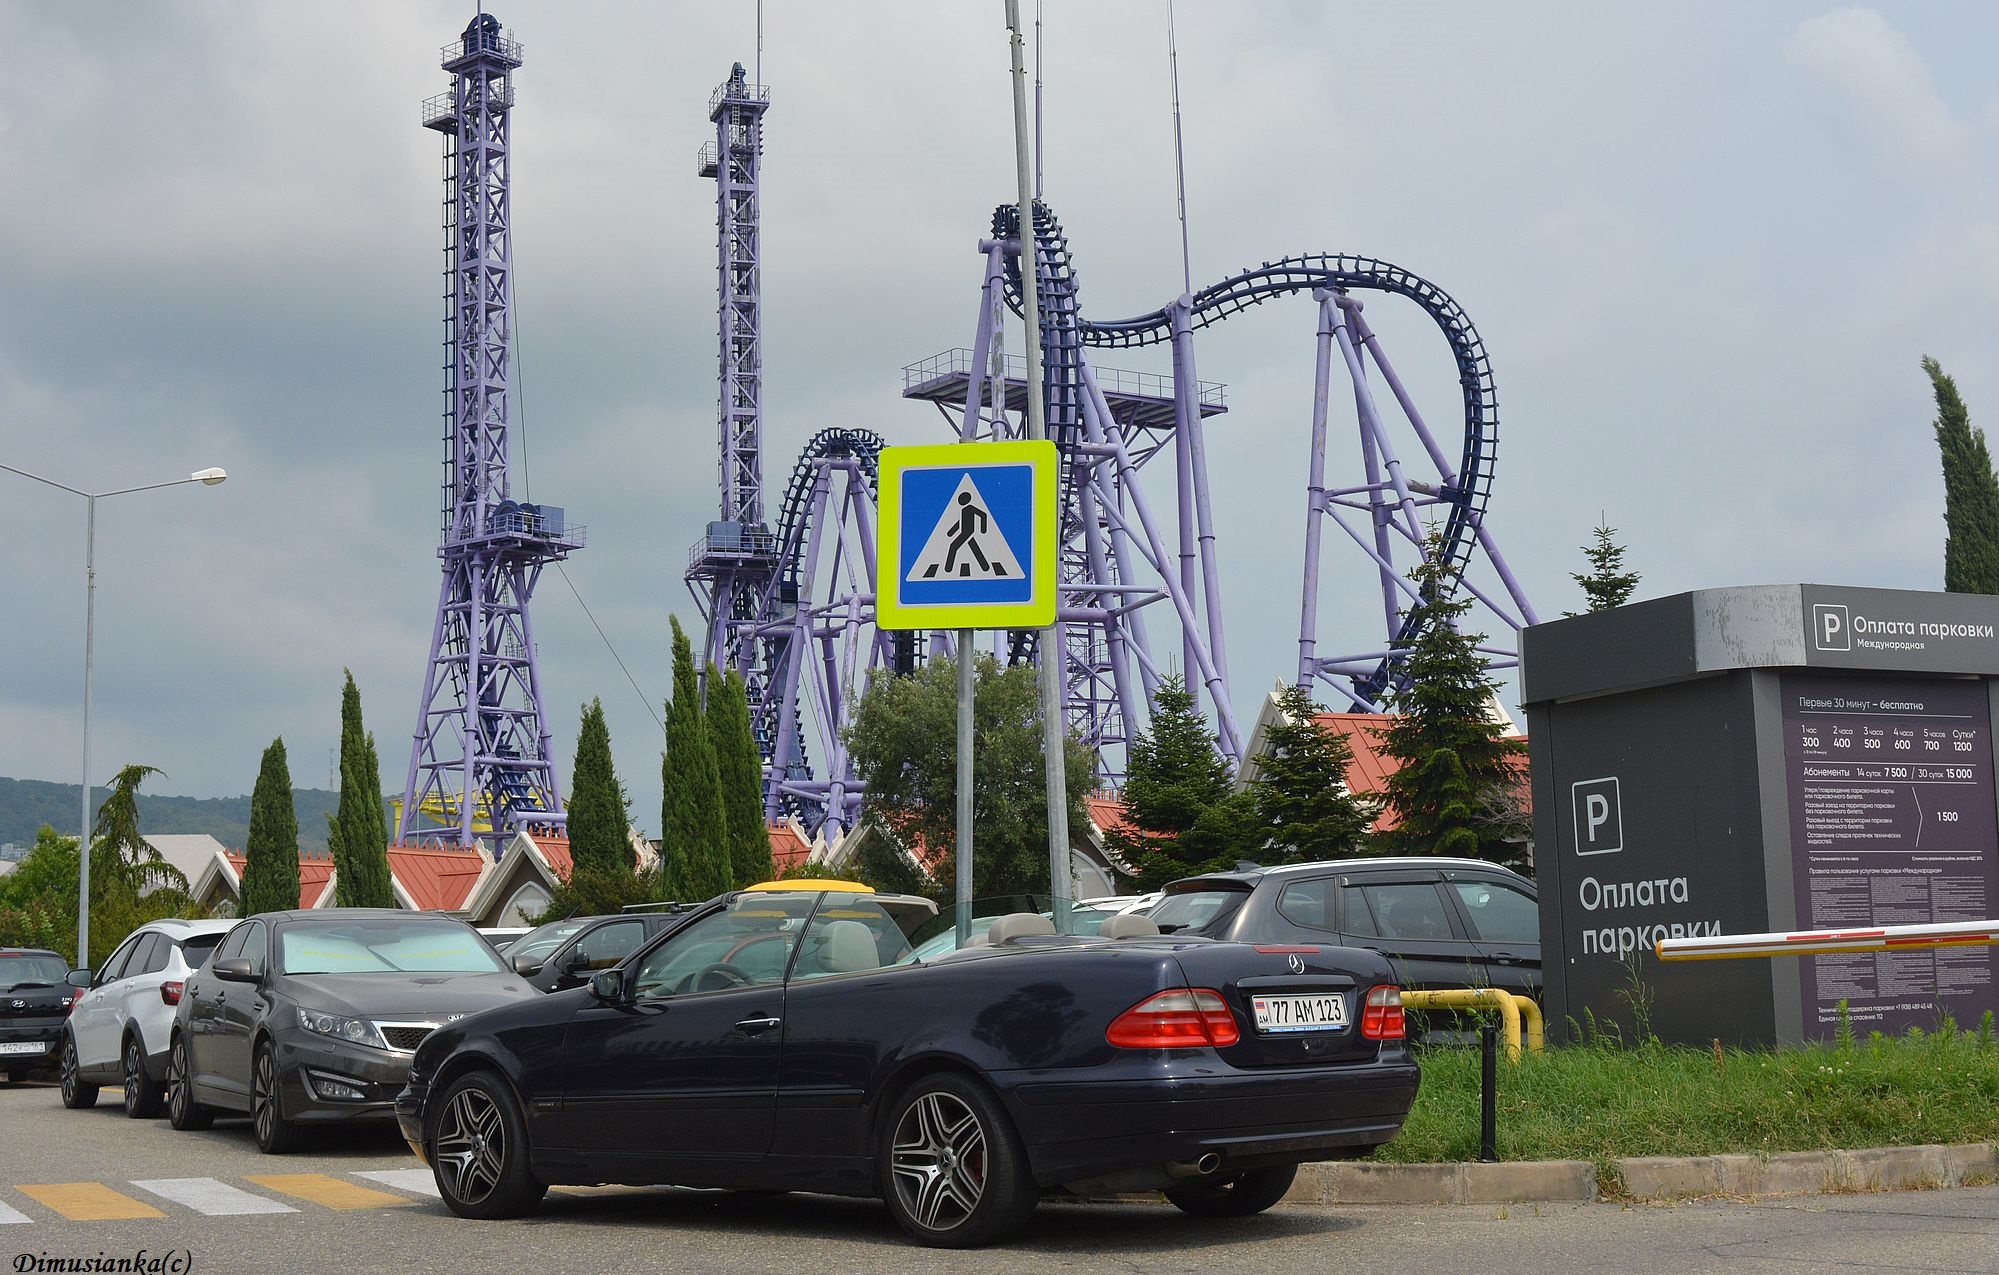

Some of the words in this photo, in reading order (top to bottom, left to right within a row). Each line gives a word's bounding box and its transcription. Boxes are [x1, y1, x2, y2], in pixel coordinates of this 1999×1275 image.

[1824, 613, 1840, 642] P
[1853, 615, 1915, 635] Оплата
[1920, 621, 1994, 640] парковки
[1857, 638, 1925, 650] Международная
[1800, 697, 1832, 709] Первые
[1834, 698, 1845, 708] 30
[1846, 700, 1870, 710] минут
[1880, 700, 1923, 710] бесплатно
[1801, 725, 1806, 733] 1
[1833, 726, 1838, 734] 2
[1863, 727, 1868, 735] 3
[1893, 727, 1899, 736] 4
[1923, 728, 1928, 737] 5
[1802, 737, 1819, 748] 300
[1833, 738, 1850, 748] 400
[1864, 739, 1881, 749] 500
[1894, 739, 1911, 750] 600
[1924, 740, 1940, 751] 700
[1953, 741, 1972, 752] 1200
[1803, 767, 1850, 777] Абонементы
[1856, 768, 1865, 777] 14
[1918, 769, 1928, 778] 30
[1586, 794, 1608, 841] P
[1580, 877, 1688, 911] Оплата
[1583, 920, 1722, 961] парковки
[1272, 1001, 1288, 1023] 77
[1295, 1000, 1315, 1022] AM
[1316, 999, 1341, 1021] 123
[1259, 1015, 1269, 1024] AM
